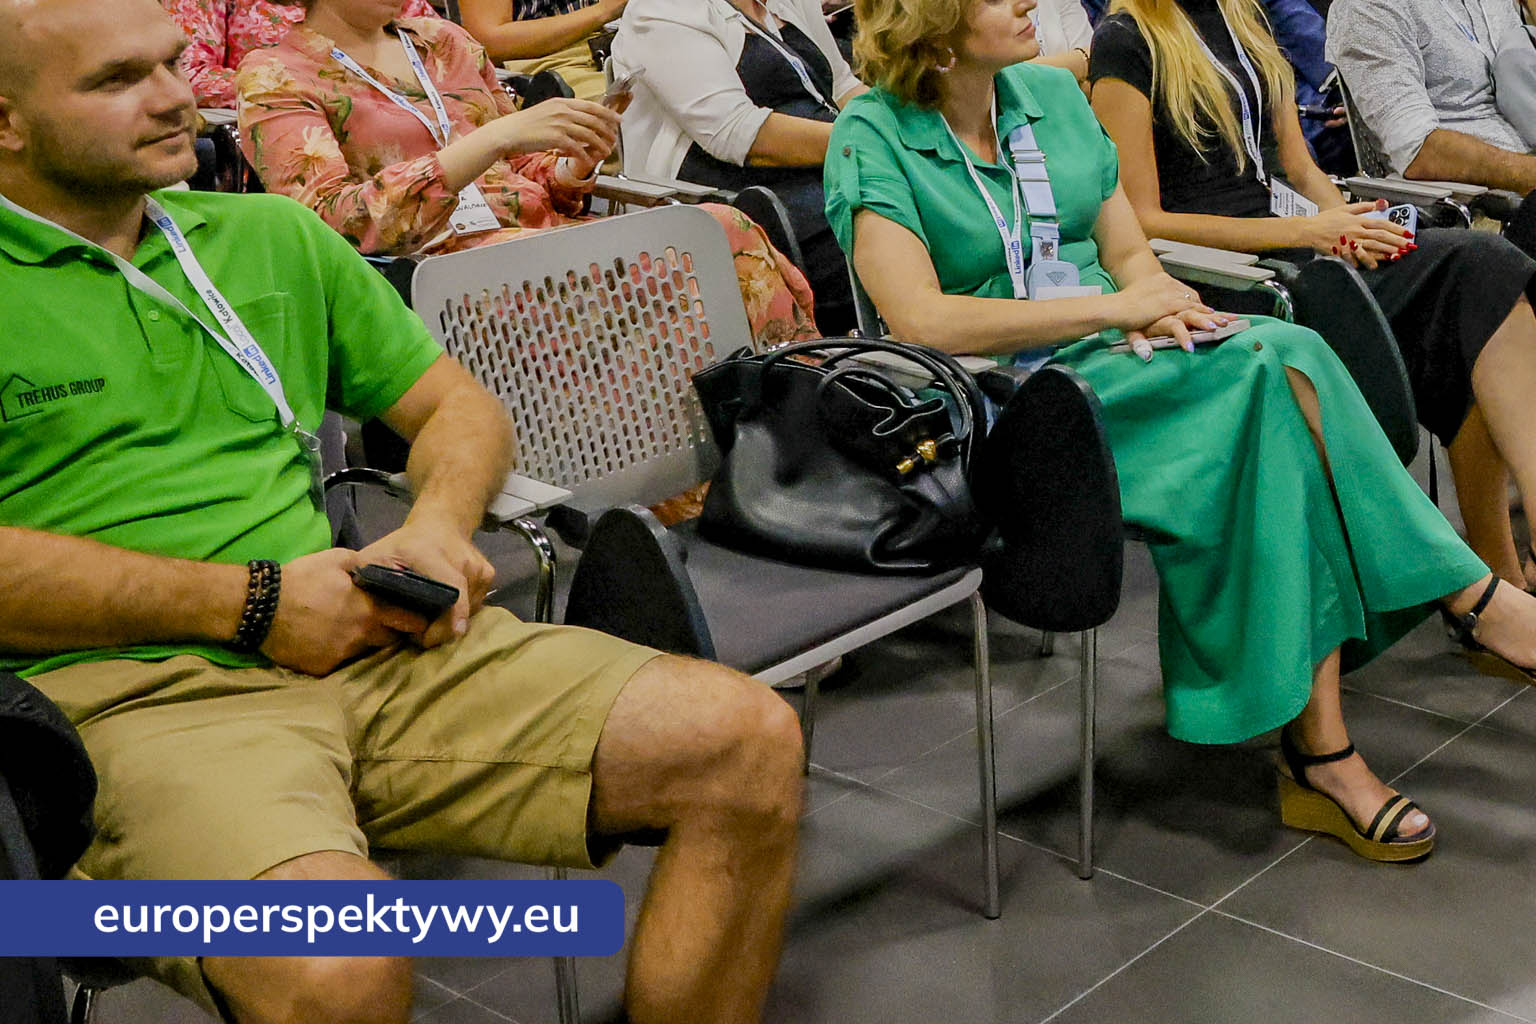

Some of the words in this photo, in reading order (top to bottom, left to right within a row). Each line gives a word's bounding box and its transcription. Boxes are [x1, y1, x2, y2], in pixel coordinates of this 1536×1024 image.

[205, 289, 232, 325] Katowice
[16, 383, 68, 409] TREHUS
[68, 378, 105, 396] GROUP
